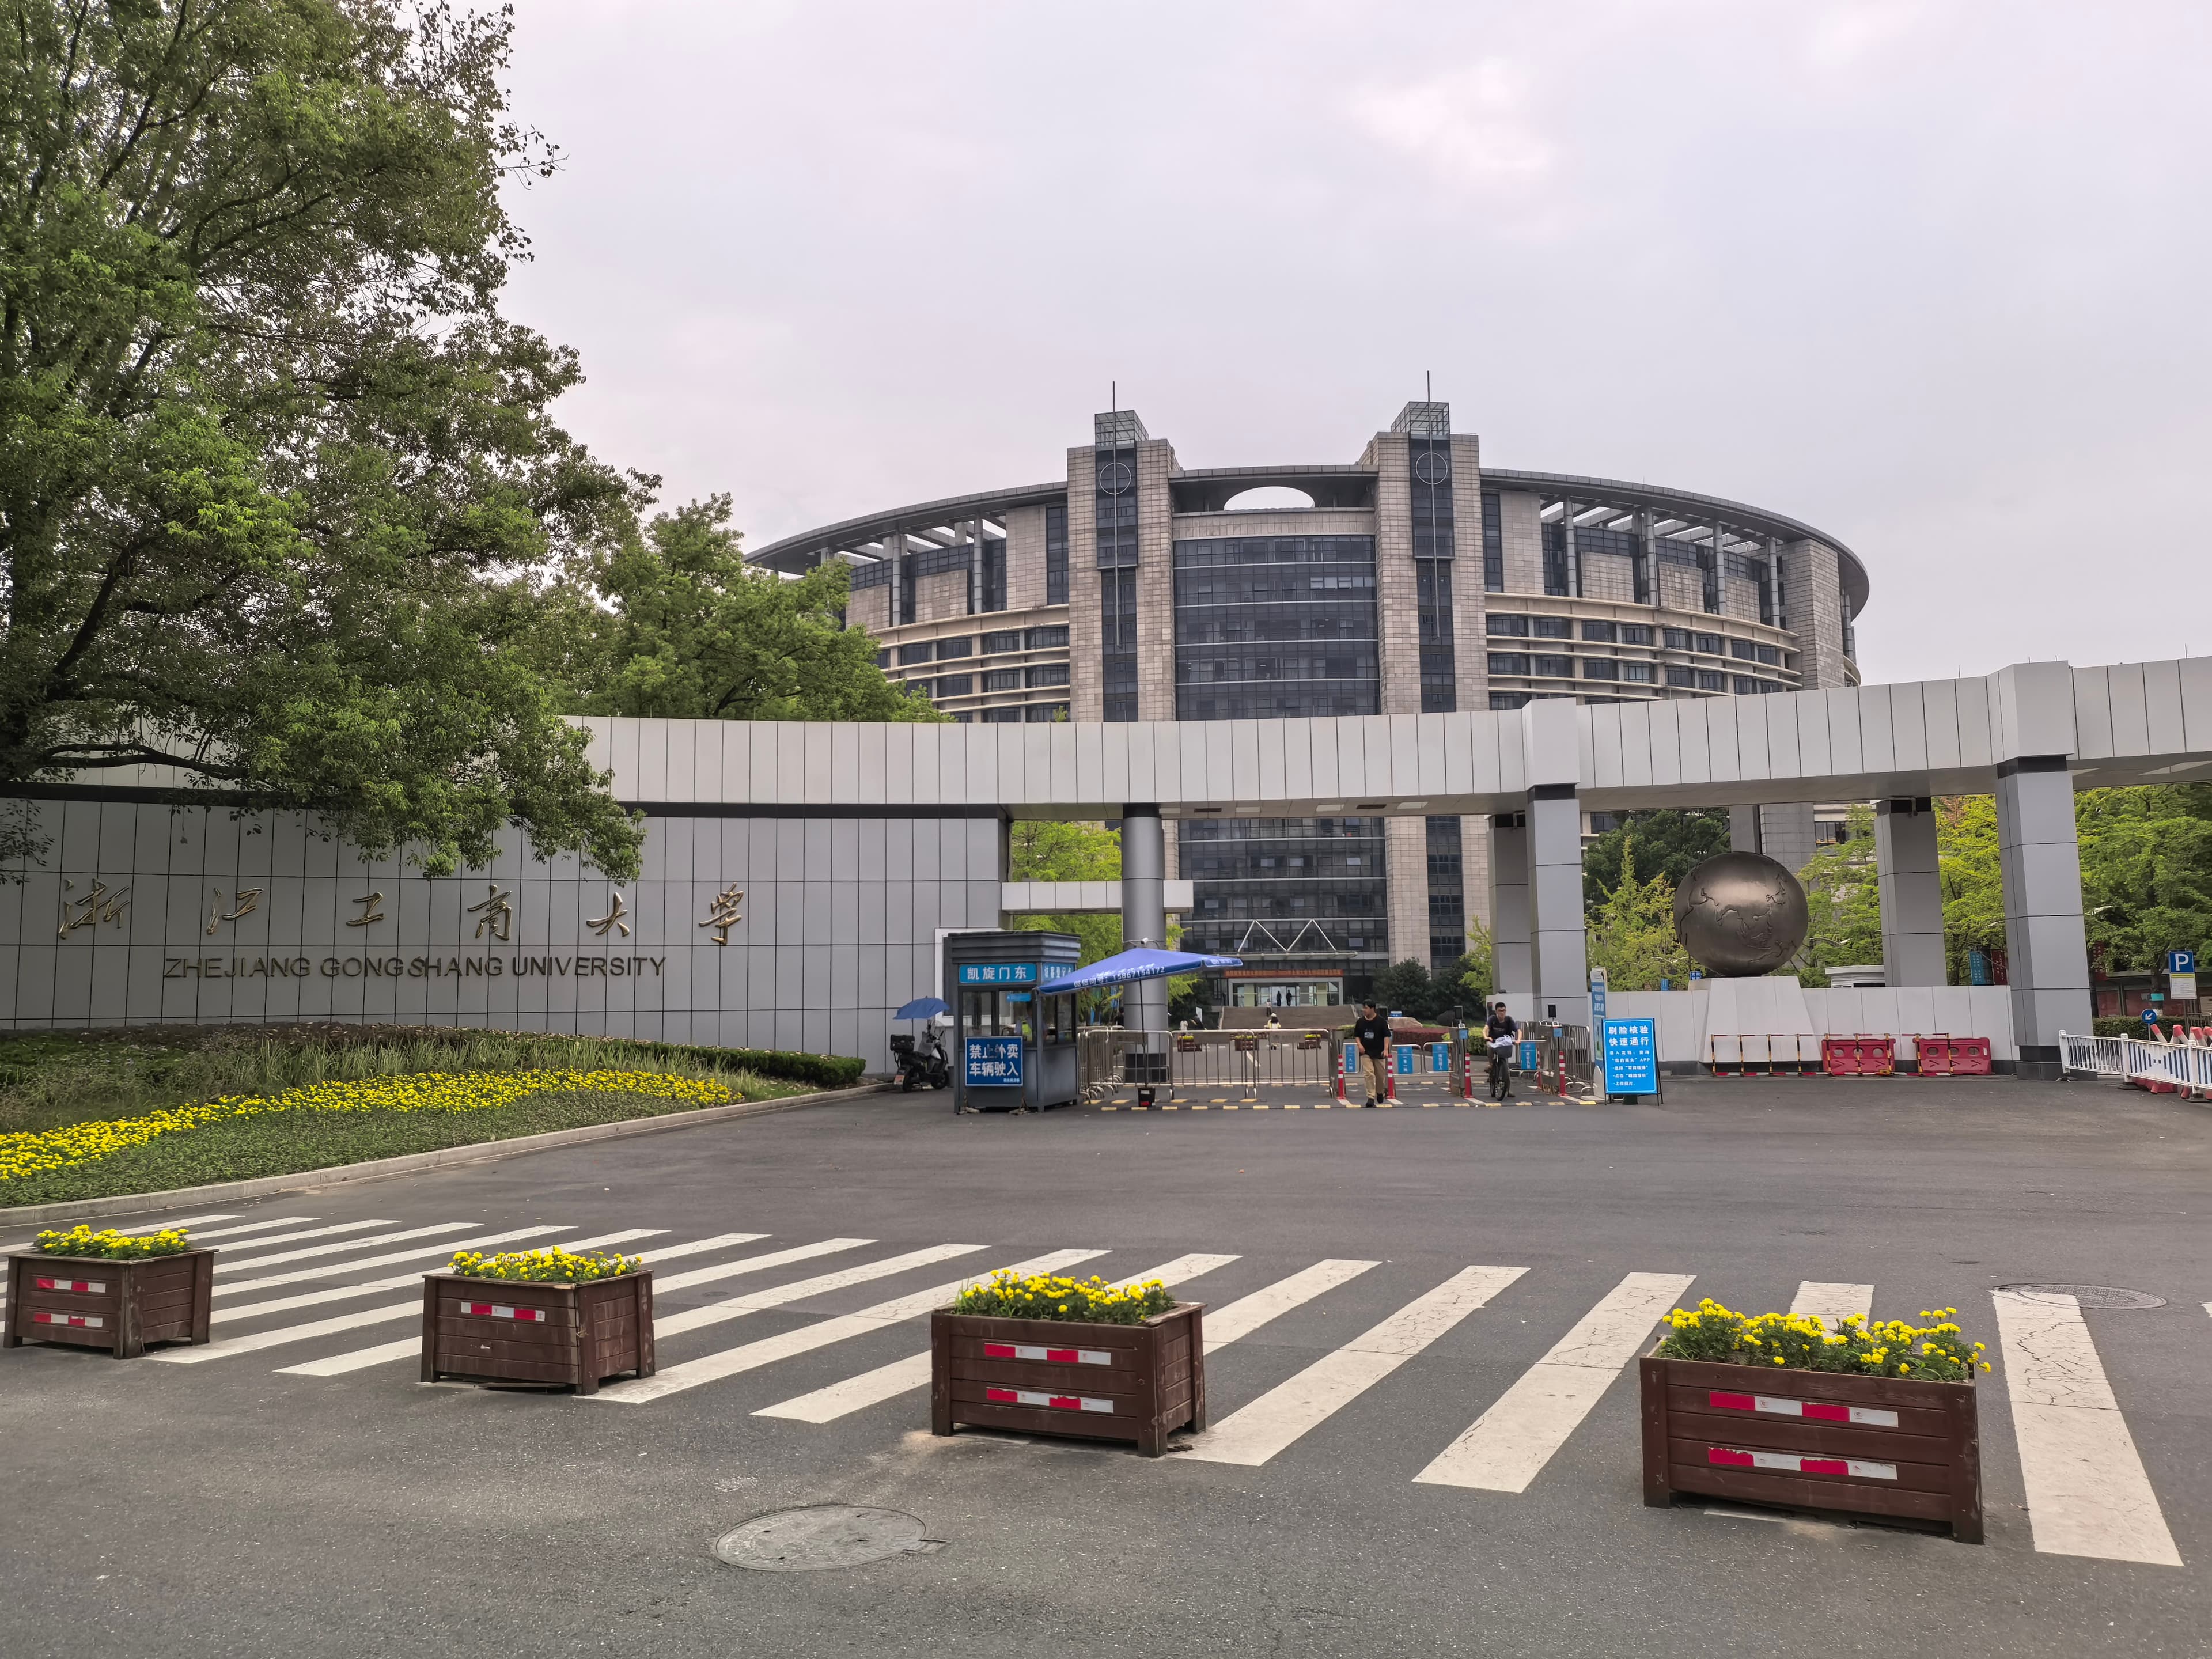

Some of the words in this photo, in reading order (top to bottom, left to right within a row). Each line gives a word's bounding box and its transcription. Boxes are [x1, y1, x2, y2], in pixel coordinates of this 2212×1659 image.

[58, 878, 744, 945] 浙江工商大学
[164, 957, 311, 978] ZHEJIANG
[320, 956, 503, 978] GONGSHANG
[512, 957, 666, 976] UNIVERSITY
[2175, 953, 2189, 971] P
[967, 965, 1027, 980] 凯旋门东
[1608, 1025, 1649, 1035] 刷脸核验
[1609, 1037, 1649, 1046] 快速通行
[969, 1061, 1018, 1077] 车辆驶入
